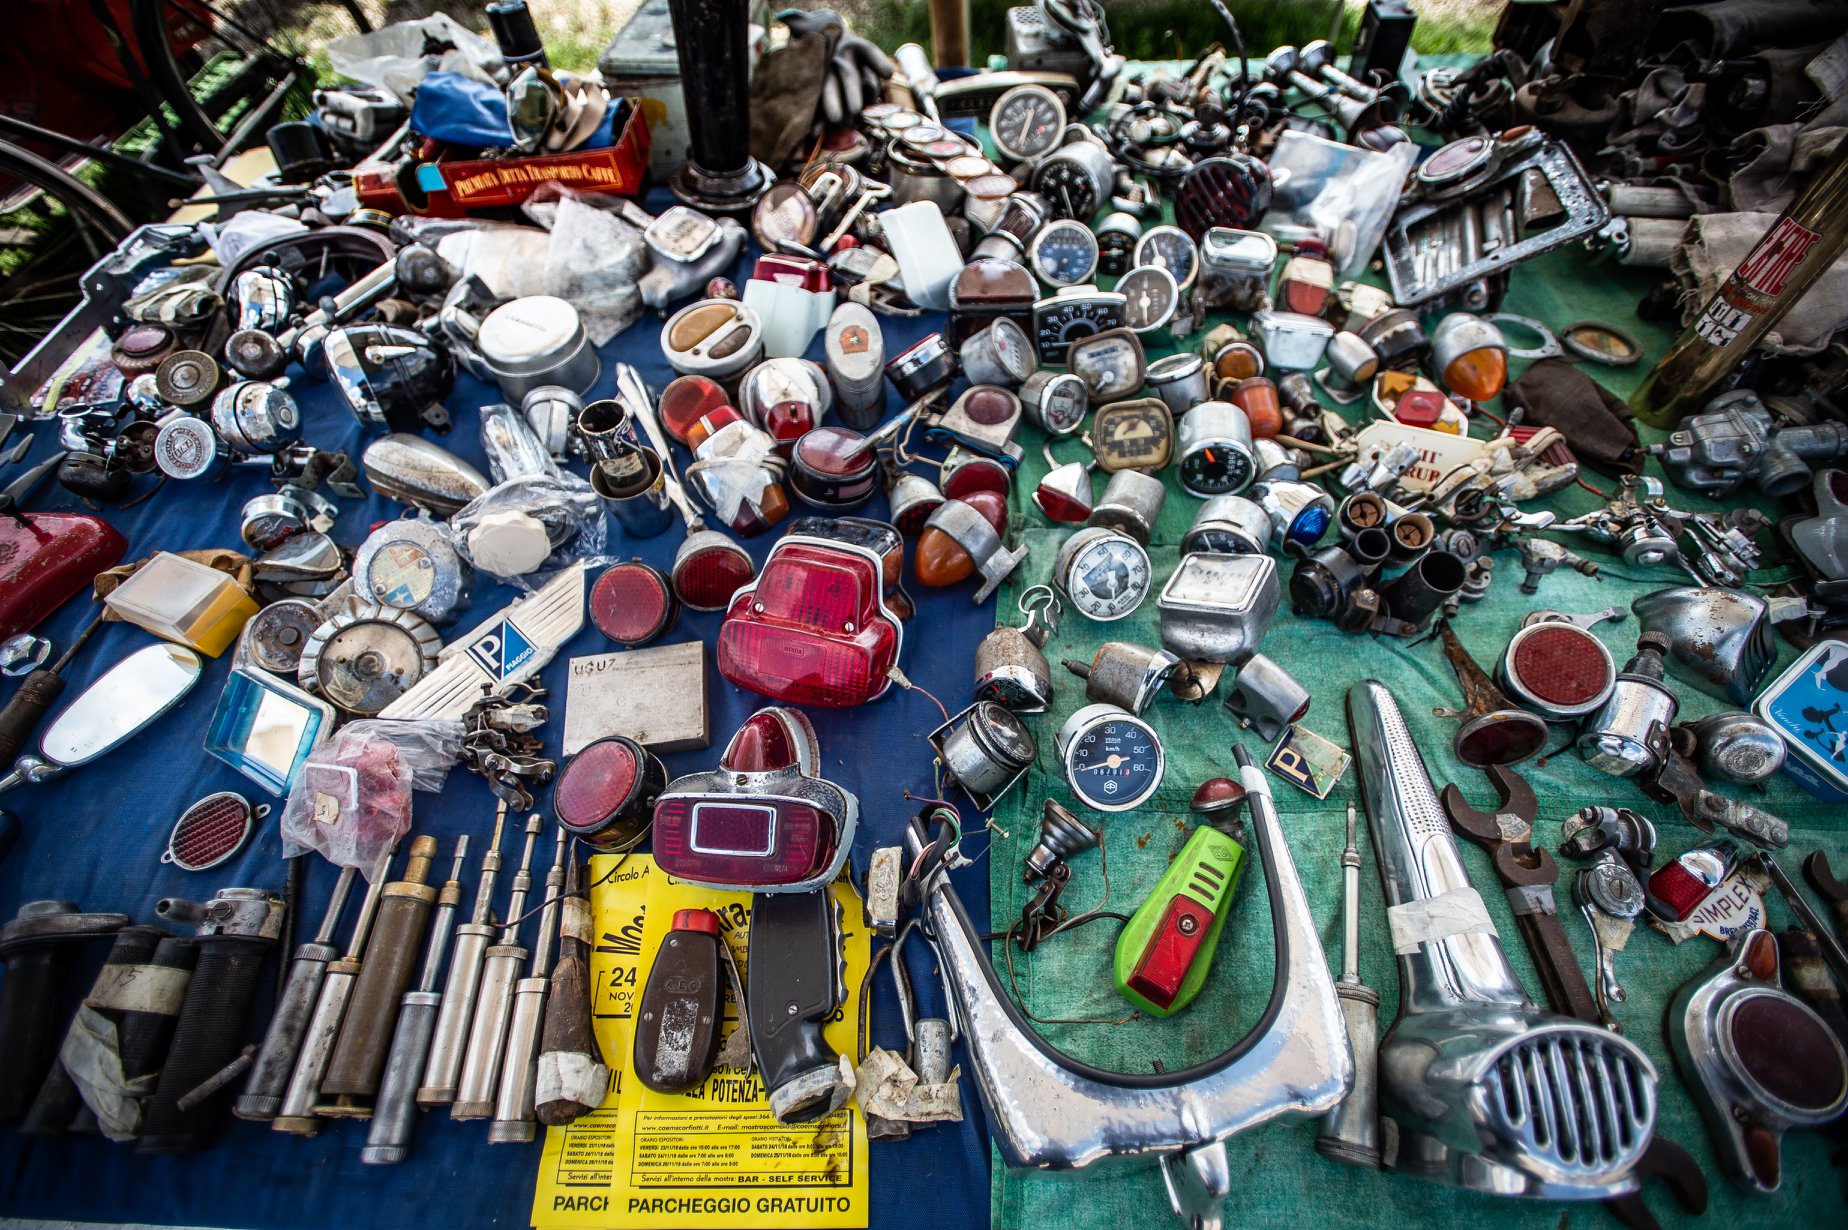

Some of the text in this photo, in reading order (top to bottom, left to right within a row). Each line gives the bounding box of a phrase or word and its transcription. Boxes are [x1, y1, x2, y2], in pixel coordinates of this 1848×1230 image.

[1040, 328, 1050, 336] 20
[1097, 546, 1109, 558] 50
[1131, 564, 1143, 576] 70
[1078, 588, 1090, 599] 30
[1090, 600, 1102, 612] 20
[471, 634, 501, 670] P
[505, 647, 533, 671] PIAGGIO
[1104, 726, 1116, 734] 30
[1133, 746, 1145, 754] 50
[1133, 764, 1145, 772] 60
[1273, 748, 1308, 784] P
[610, 966, 637, 988] 24
[609, 992, 634, 1000] NOV
[568, 1172, 588, 1180] Servizi
[641, 1174, 662, 1182] Servizi
[664, 1174, 694, 1182] all'interno
[696, 1174, 712, 1182] della
[627, 1196, 850, 1214] PARCHEGGIO GRATUITO
